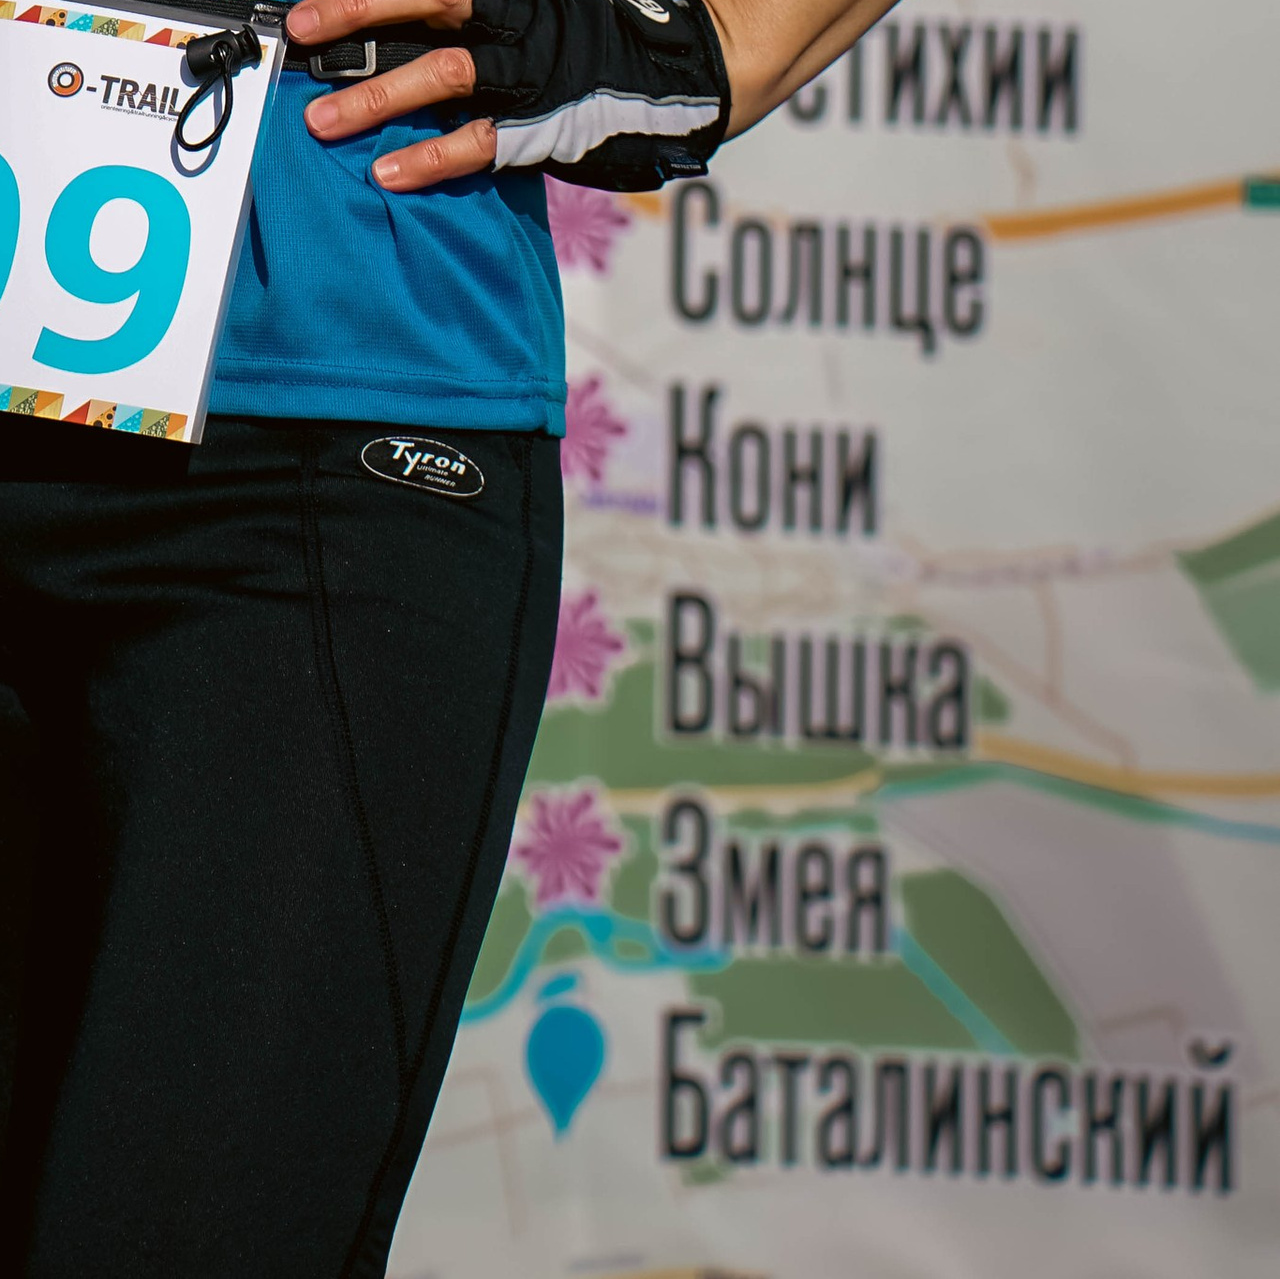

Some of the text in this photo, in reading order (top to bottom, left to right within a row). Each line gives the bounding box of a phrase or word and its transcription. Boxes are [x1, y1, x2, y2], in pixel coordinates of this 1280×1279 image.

[670, 180, 985, 358] Солнце
[389, 440, 467, 476] Tyron
[666, 382, 879, 537] Кони
[666, 591, 970, 749] Вышка
[660, 798, 889, 953] Змея
[659, 1006, 1239, 1196] Баталинский
